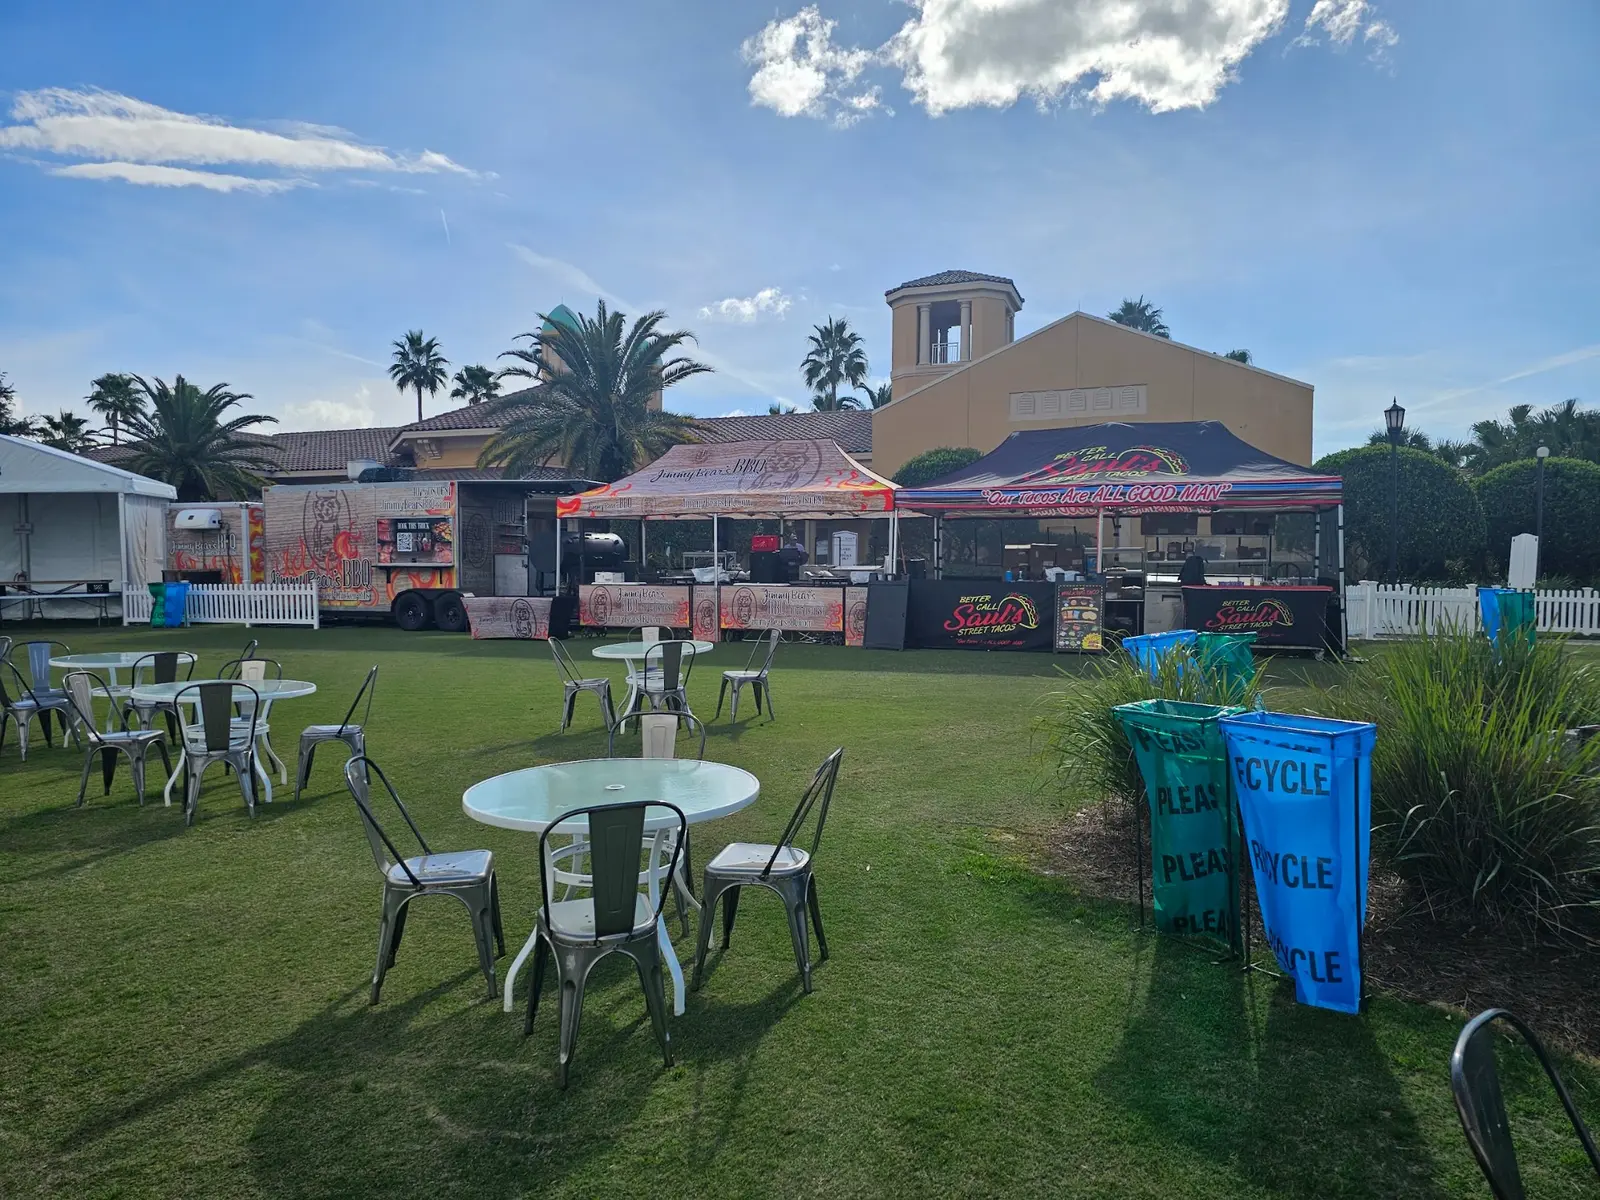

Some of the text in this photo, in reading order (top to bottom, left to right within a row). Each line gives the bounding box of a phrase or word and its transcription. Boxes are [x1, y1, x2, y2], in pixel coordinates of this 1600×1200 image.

[1081, 452, 1118, 462] CALL
[650, 468, 696, 483] Jimmy
[732, 458, 768, 476] BBQ
[1023, 455, 1162, 481] Saul's
[1105, 470, 1149, 478] TACOS
[1018, 489, 1059, 505] Tacos
[1060, 487, 1089, 504] Are
[1090, 484, 1125, 503] ALL
[1126, 484, 1178, 503] GOOD
[342, 559, 372, 590] BBQ
[761, 588, 816, 605] Jimmy Bear's
[959, 595, 992, 603] BETTER
[1222, 599, 1251, 607] BETTER
[976, 603, 998, 611] CALL
[943, 603, 1025, 631] Saul's
[1205, 606, 1280, 628] Saul's
[957, 623, 1017, 636] STREET TACOS
[1218, 620, 1274, 632] STREET TACOS
[1234, 757, 1330, 796] ECYCLE
